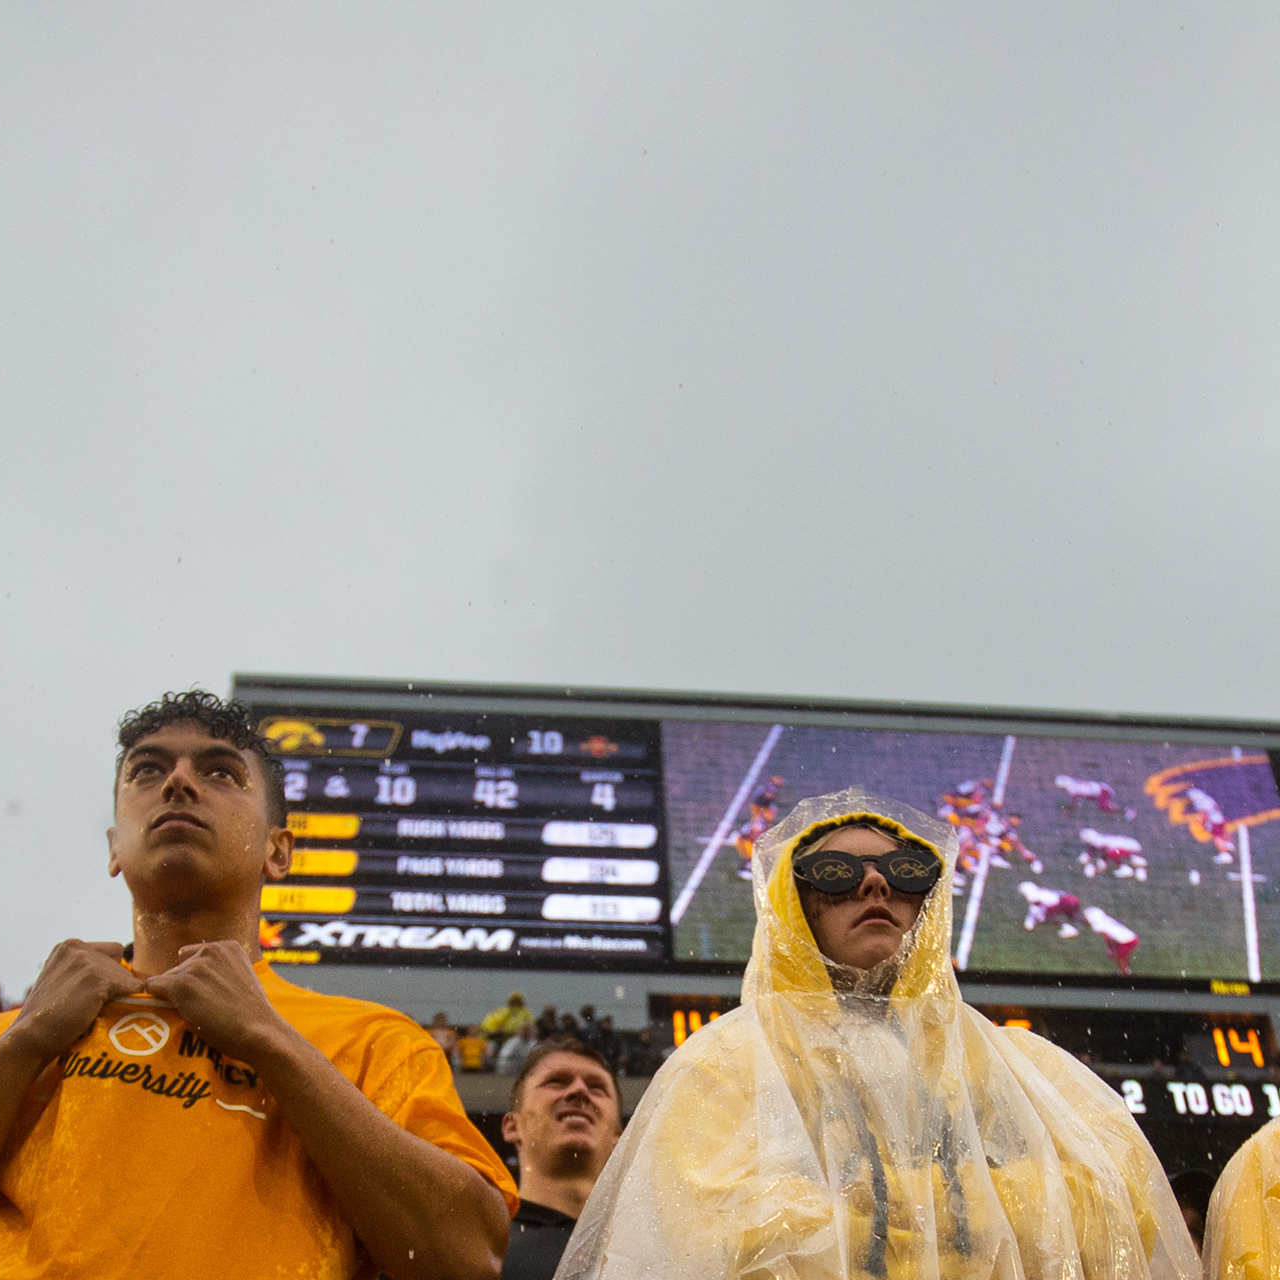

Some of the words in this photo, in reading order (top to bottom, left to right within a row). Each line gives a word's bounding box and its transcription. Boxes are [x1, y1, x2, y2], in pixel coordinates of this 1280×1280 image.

[349, 723, 370, 748] 7
[527, 730, 563, 755] 10
[284, 772, 308, 801] 2
[323, 775, 350, 799] &
[375, 775, 417, 806] 10
[472, 780, 519, 809] 42
[591, 783, 616, 812] 4
[291, 921, 515, 951] XTREAM
[1212, 1027, 1265, 1067] 14
[1166, 1081, 1209, 1115] TO
[1212, 1083, 1254, 1116] GO
